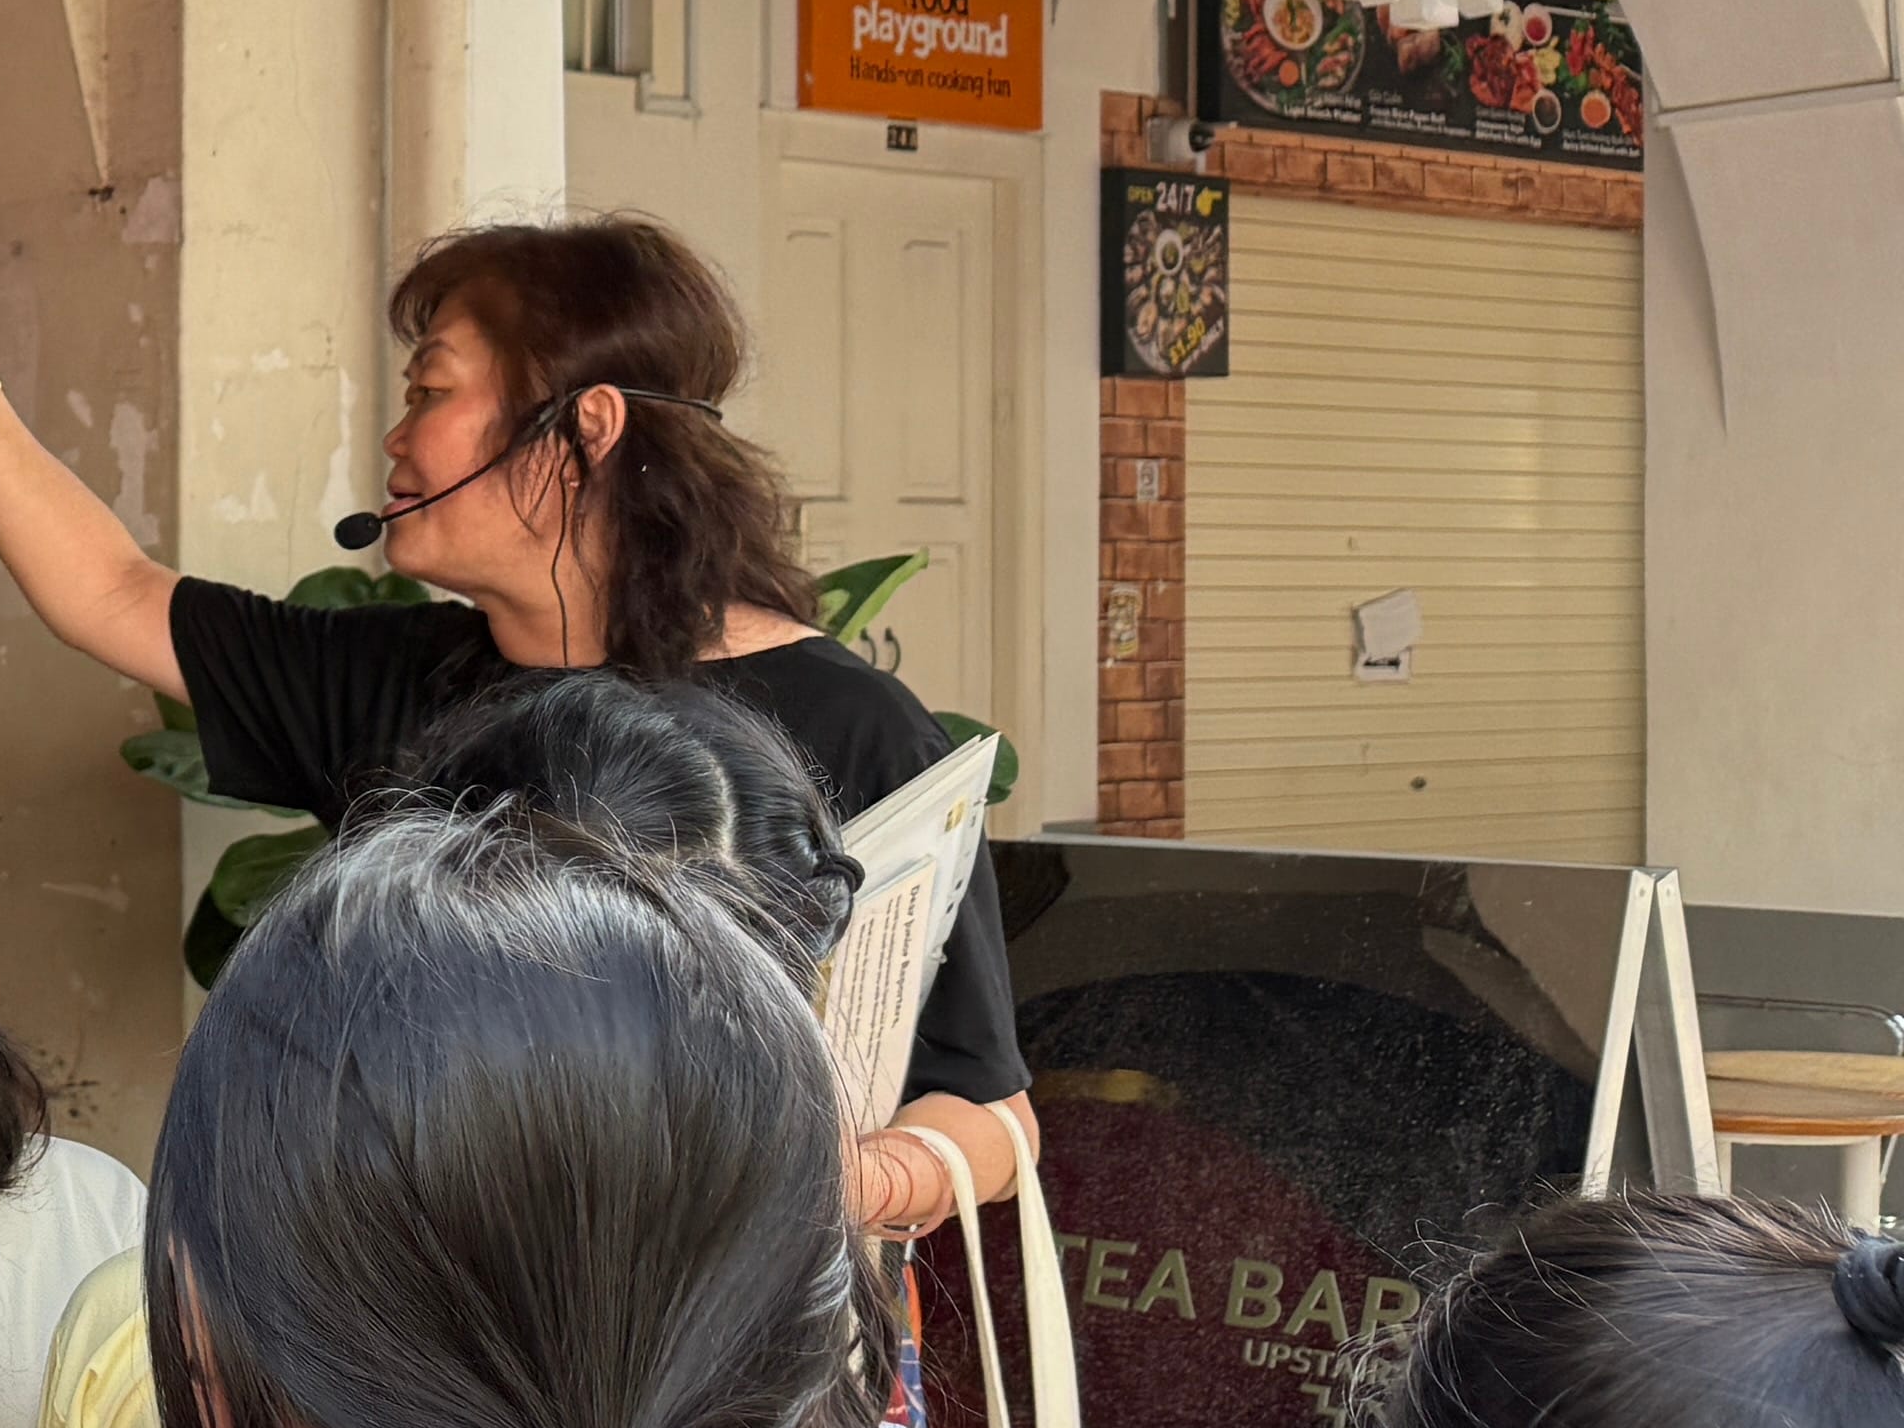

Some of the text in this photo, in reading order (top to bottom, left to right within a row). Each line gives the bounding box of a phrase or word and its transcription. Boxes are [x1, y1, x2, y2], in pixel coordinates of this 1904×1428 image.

[850, 56, 1012, 98] Hands-on cooking fun
[1155, 180, 1197, 215] 24/7
